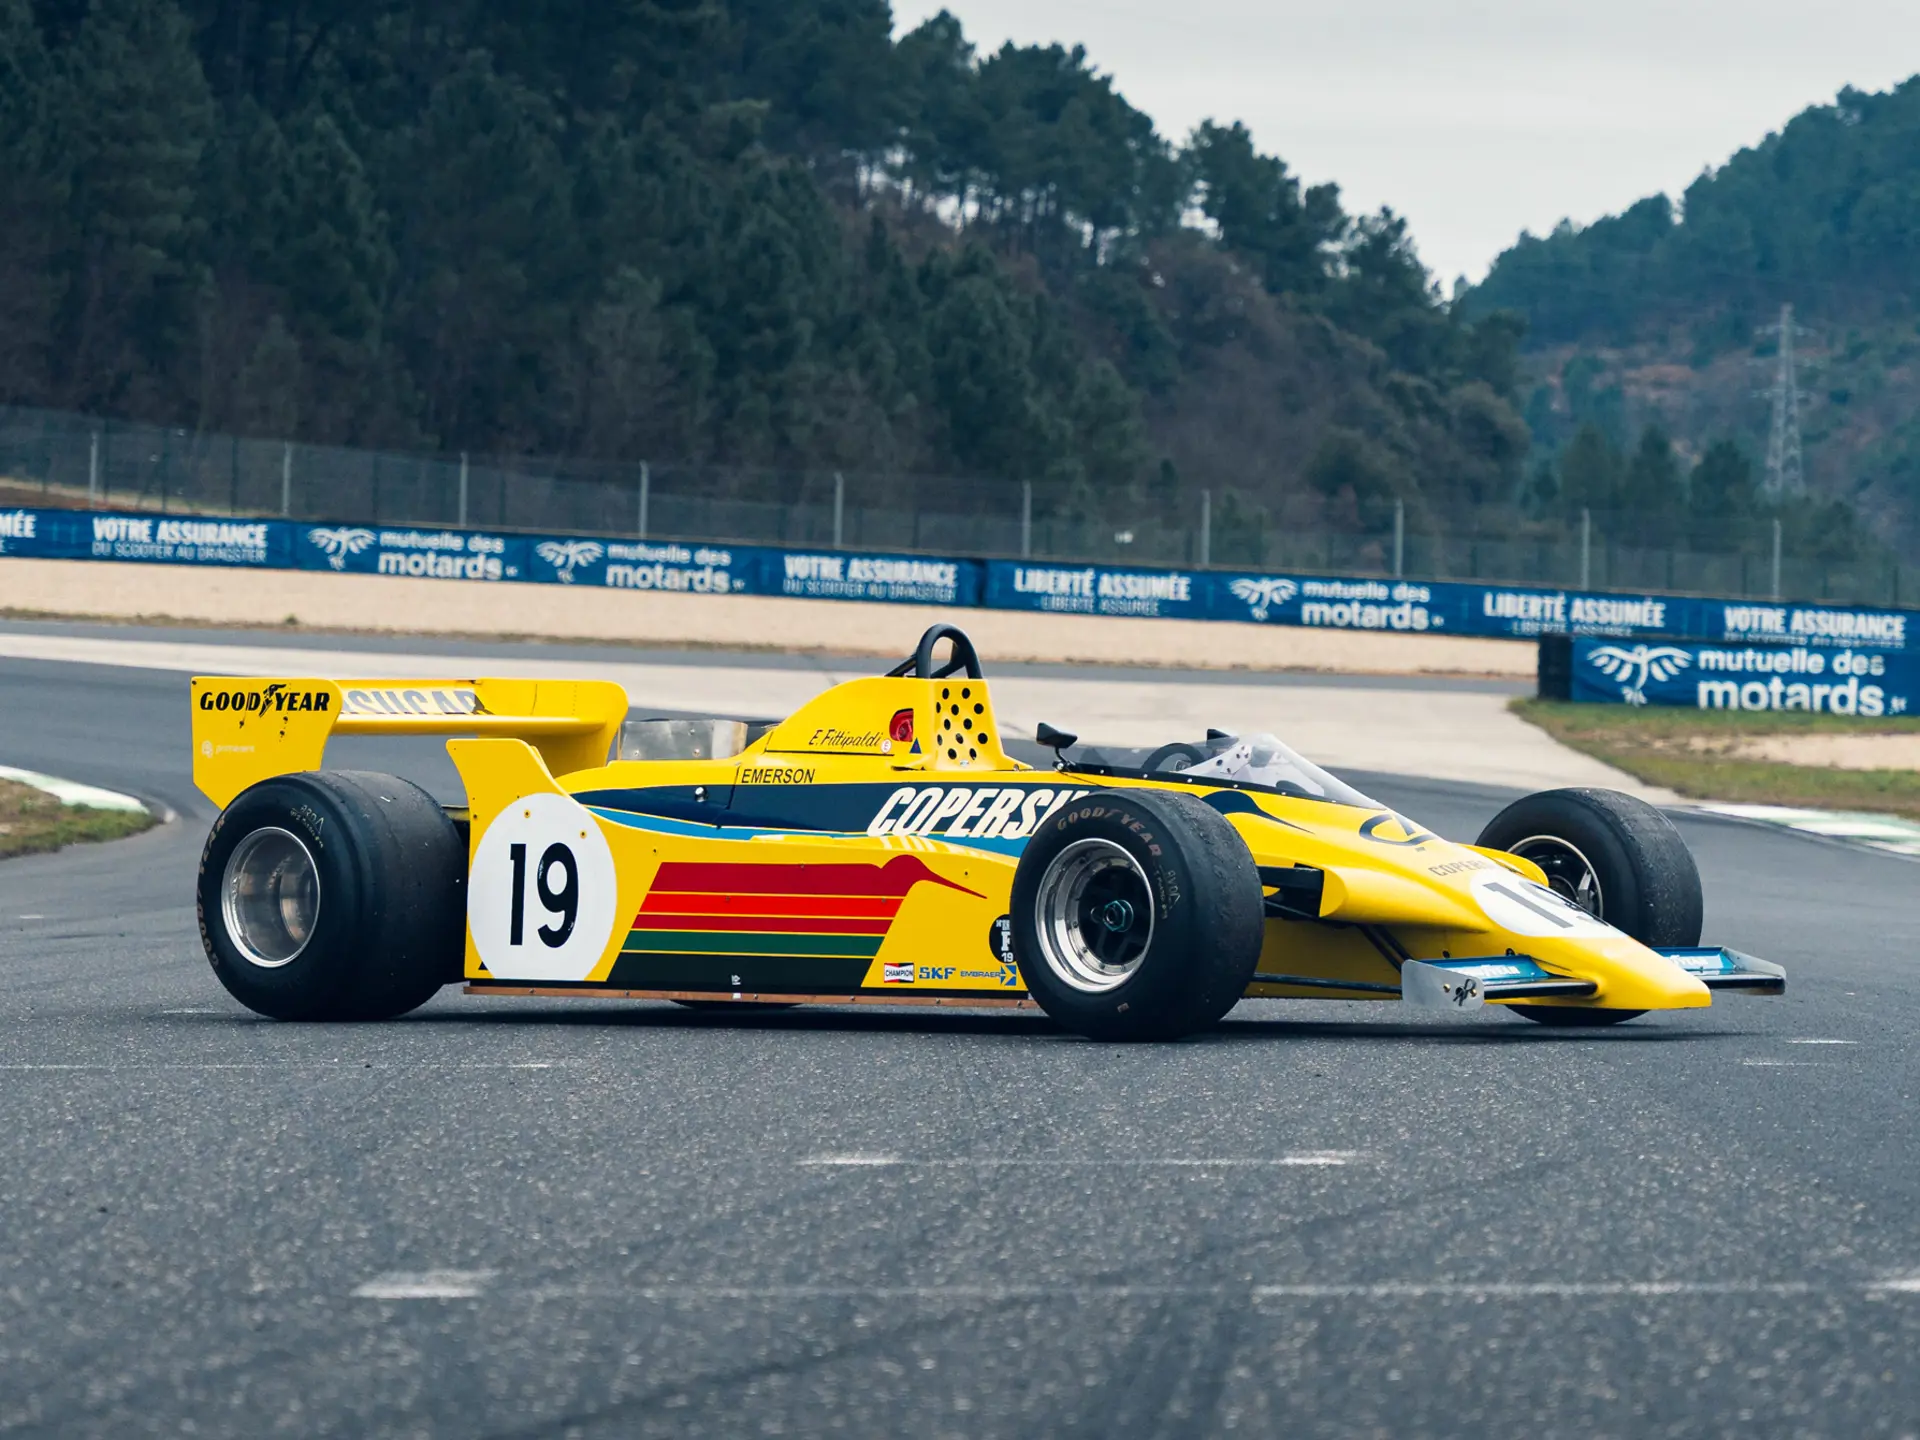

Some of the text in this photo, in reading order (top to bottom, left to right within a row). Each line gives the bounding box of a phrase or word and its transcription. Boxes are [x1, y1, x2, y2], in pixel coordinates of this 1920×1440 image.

[92, 516, 268, 548] VOTRE ASSURANCE
[379, 530, 505, 553] mutuelle des
[91, 541, 112, 556] DU
[114, 542, 174, 559] SCOOTER
[607, 543, 731, 566] mutuelle des
[378, 551, 502, 580] motards
[606, 563, 730, 592] motards
[784, 554, 957, 588] VOTRE ASSURANCE
[1014, 568, 1191, 601] LIBERTÉ ASSUMÉE
[1302, 580, 1430, 602] mutuelle des
[1301, 601, 1429, 630] motards
[1483, 591, 1666, 627] LIBERTÉ ASSUMÉE
[1724, 605, 1786, 633] VOTRE
[1790, 609, 1907, 640] ASSURANCE
[1698, 647, 1885, 676] mutuelle des
[1697, 676, 1885, 717] motards
[741, 768, 816, 784] EMERSON
[509, 842, 579, 948] 19
[885, 968, 913, 978] CHAMPION
[918, 966, 956, 980] SKF
[960, 970, 1000, 978] EMBRAER
